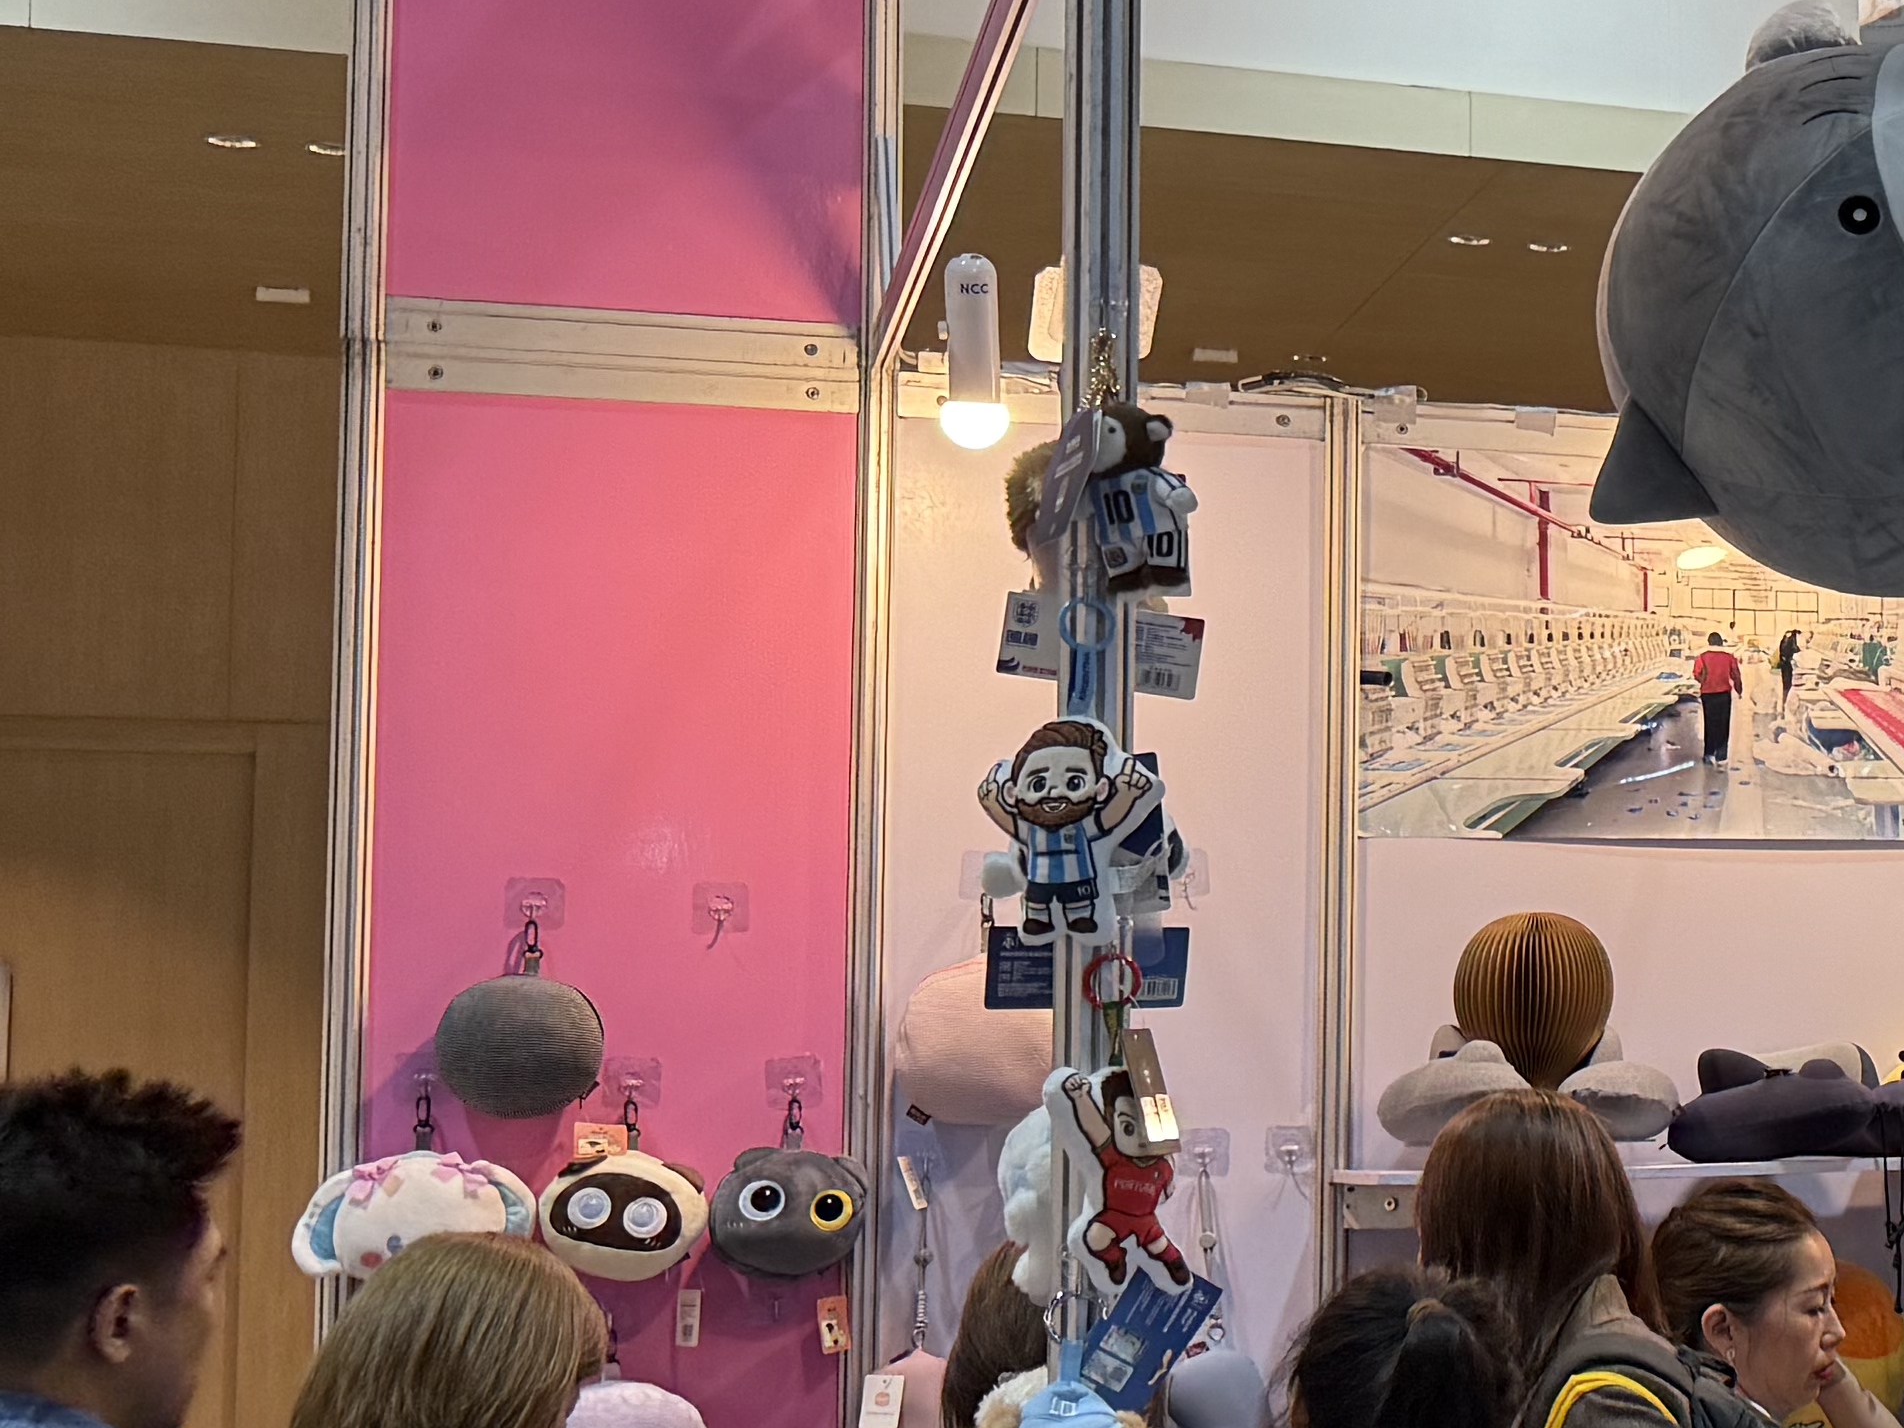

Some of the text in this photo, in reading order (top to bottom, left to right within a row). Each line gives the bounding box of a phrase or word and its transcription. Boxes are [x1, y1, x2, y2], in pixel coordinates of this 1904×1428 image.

[960, 283, 989, 294] NCC
[1103, 489, 1135, 526] 10
[1076, 885, 1091, 897] 10
